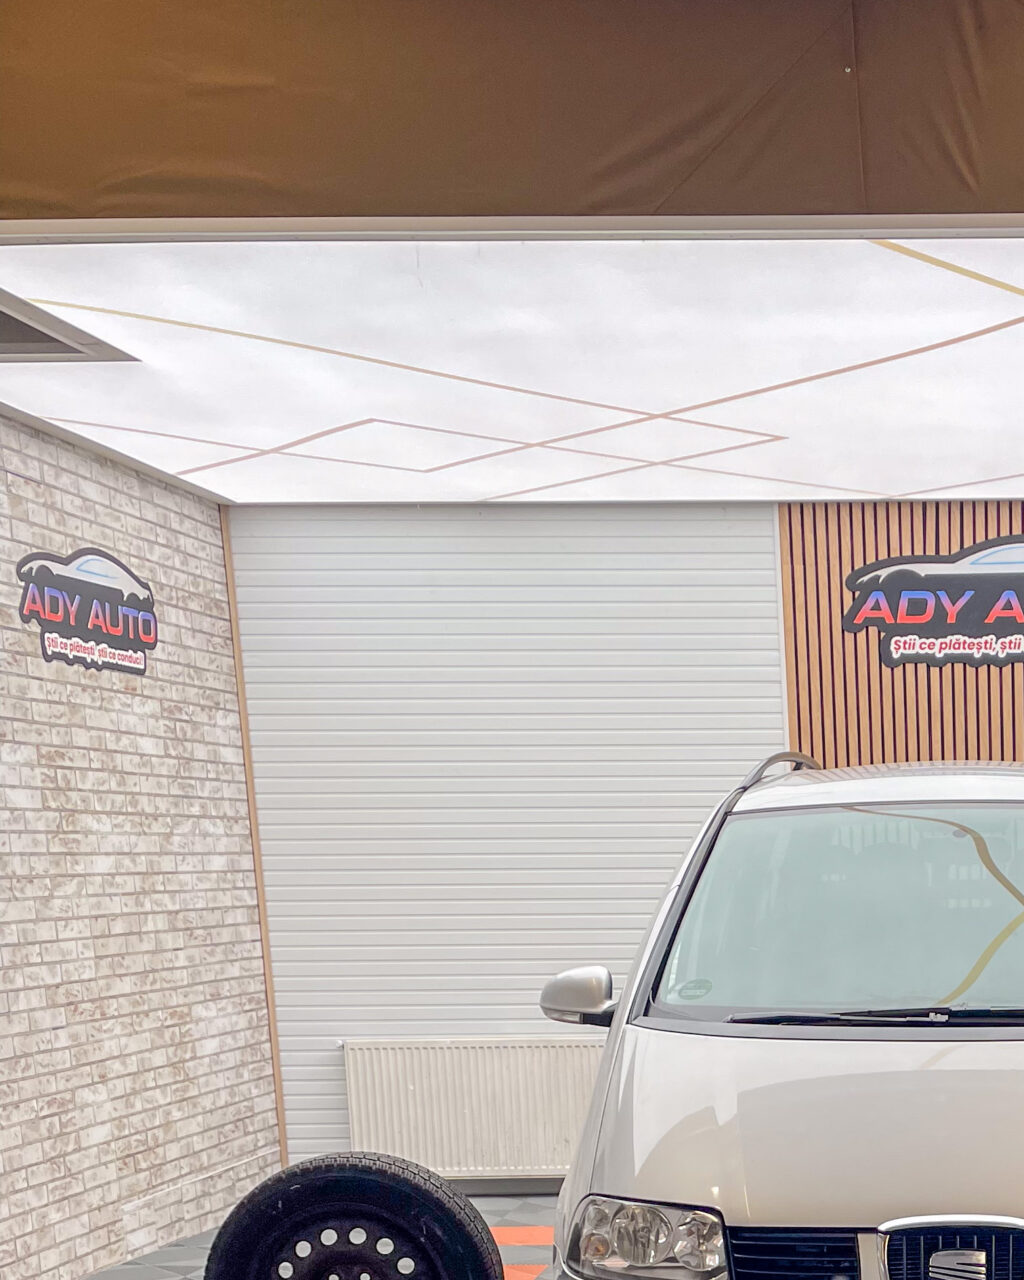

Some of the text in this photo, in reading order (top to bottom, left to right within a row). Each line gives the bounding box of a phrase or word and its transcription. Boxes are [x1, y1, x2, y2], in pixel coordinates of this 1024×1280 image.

[23, 583, 156, 643] ADY AUTO
[853, 589, 975, 624] ADY
[60, 640, 68, 650] ce
[893, 638, 916, 654] Știi
[918, 641, 936, 651] ce
